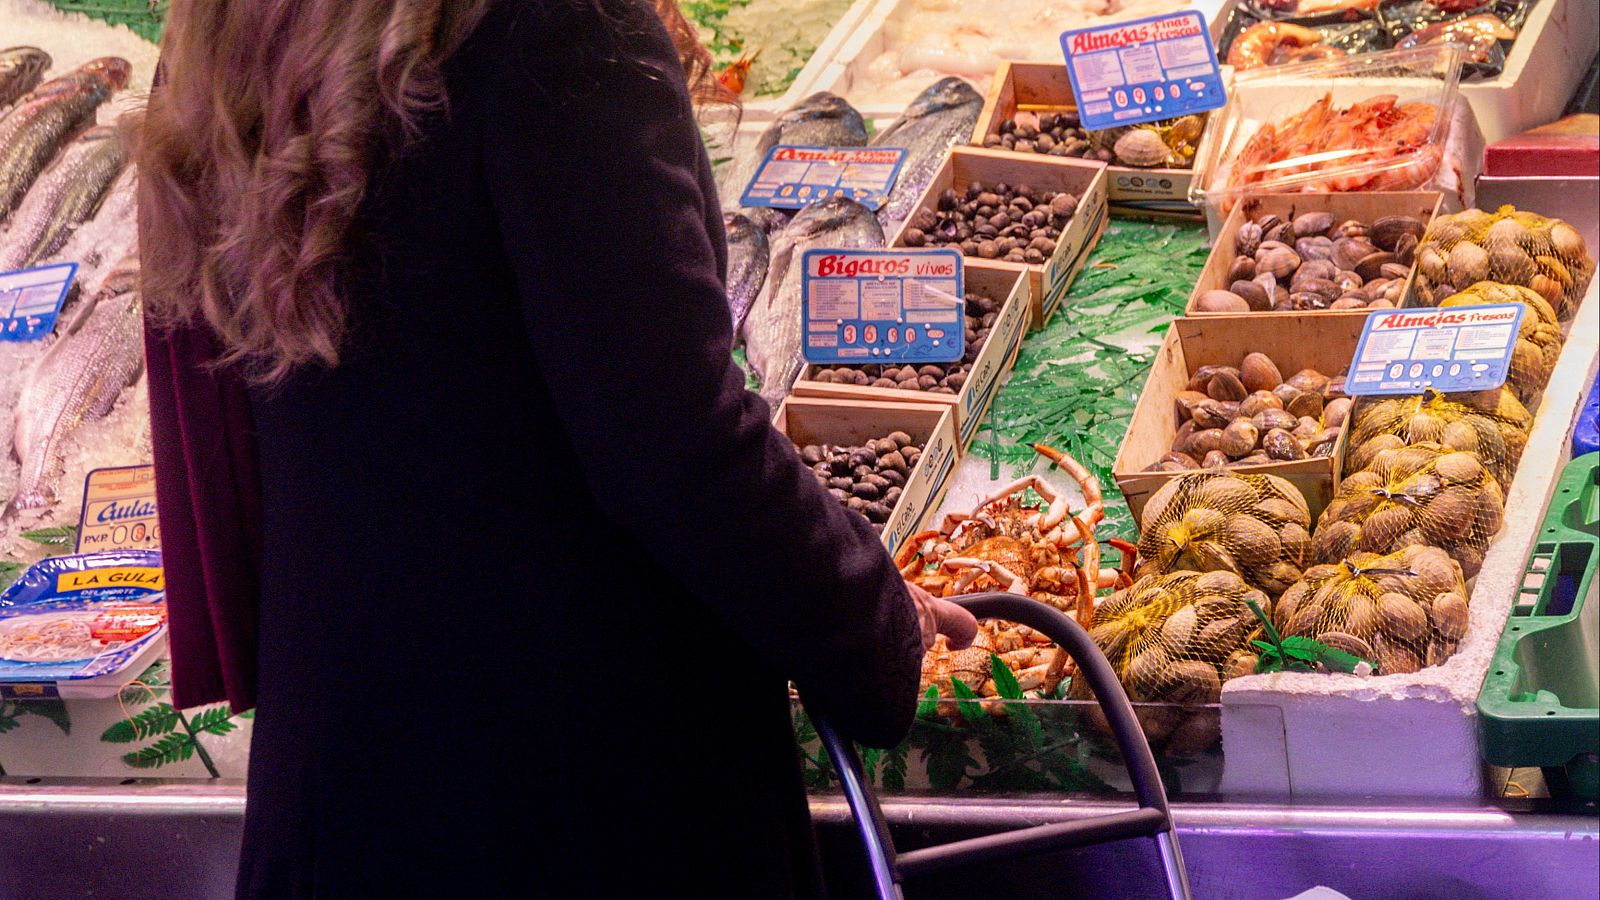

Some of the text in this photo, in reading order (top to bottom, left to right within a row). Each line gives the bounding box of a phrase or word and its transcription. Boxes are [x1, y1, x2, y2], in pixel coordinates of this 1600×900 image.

[1071, 27, 1149, 56] Almejas
[916, 262, 953, 275] vivos
[1377, 311, 1466, 329] Almejas
[73, 572, 160, 586] LA GULA
